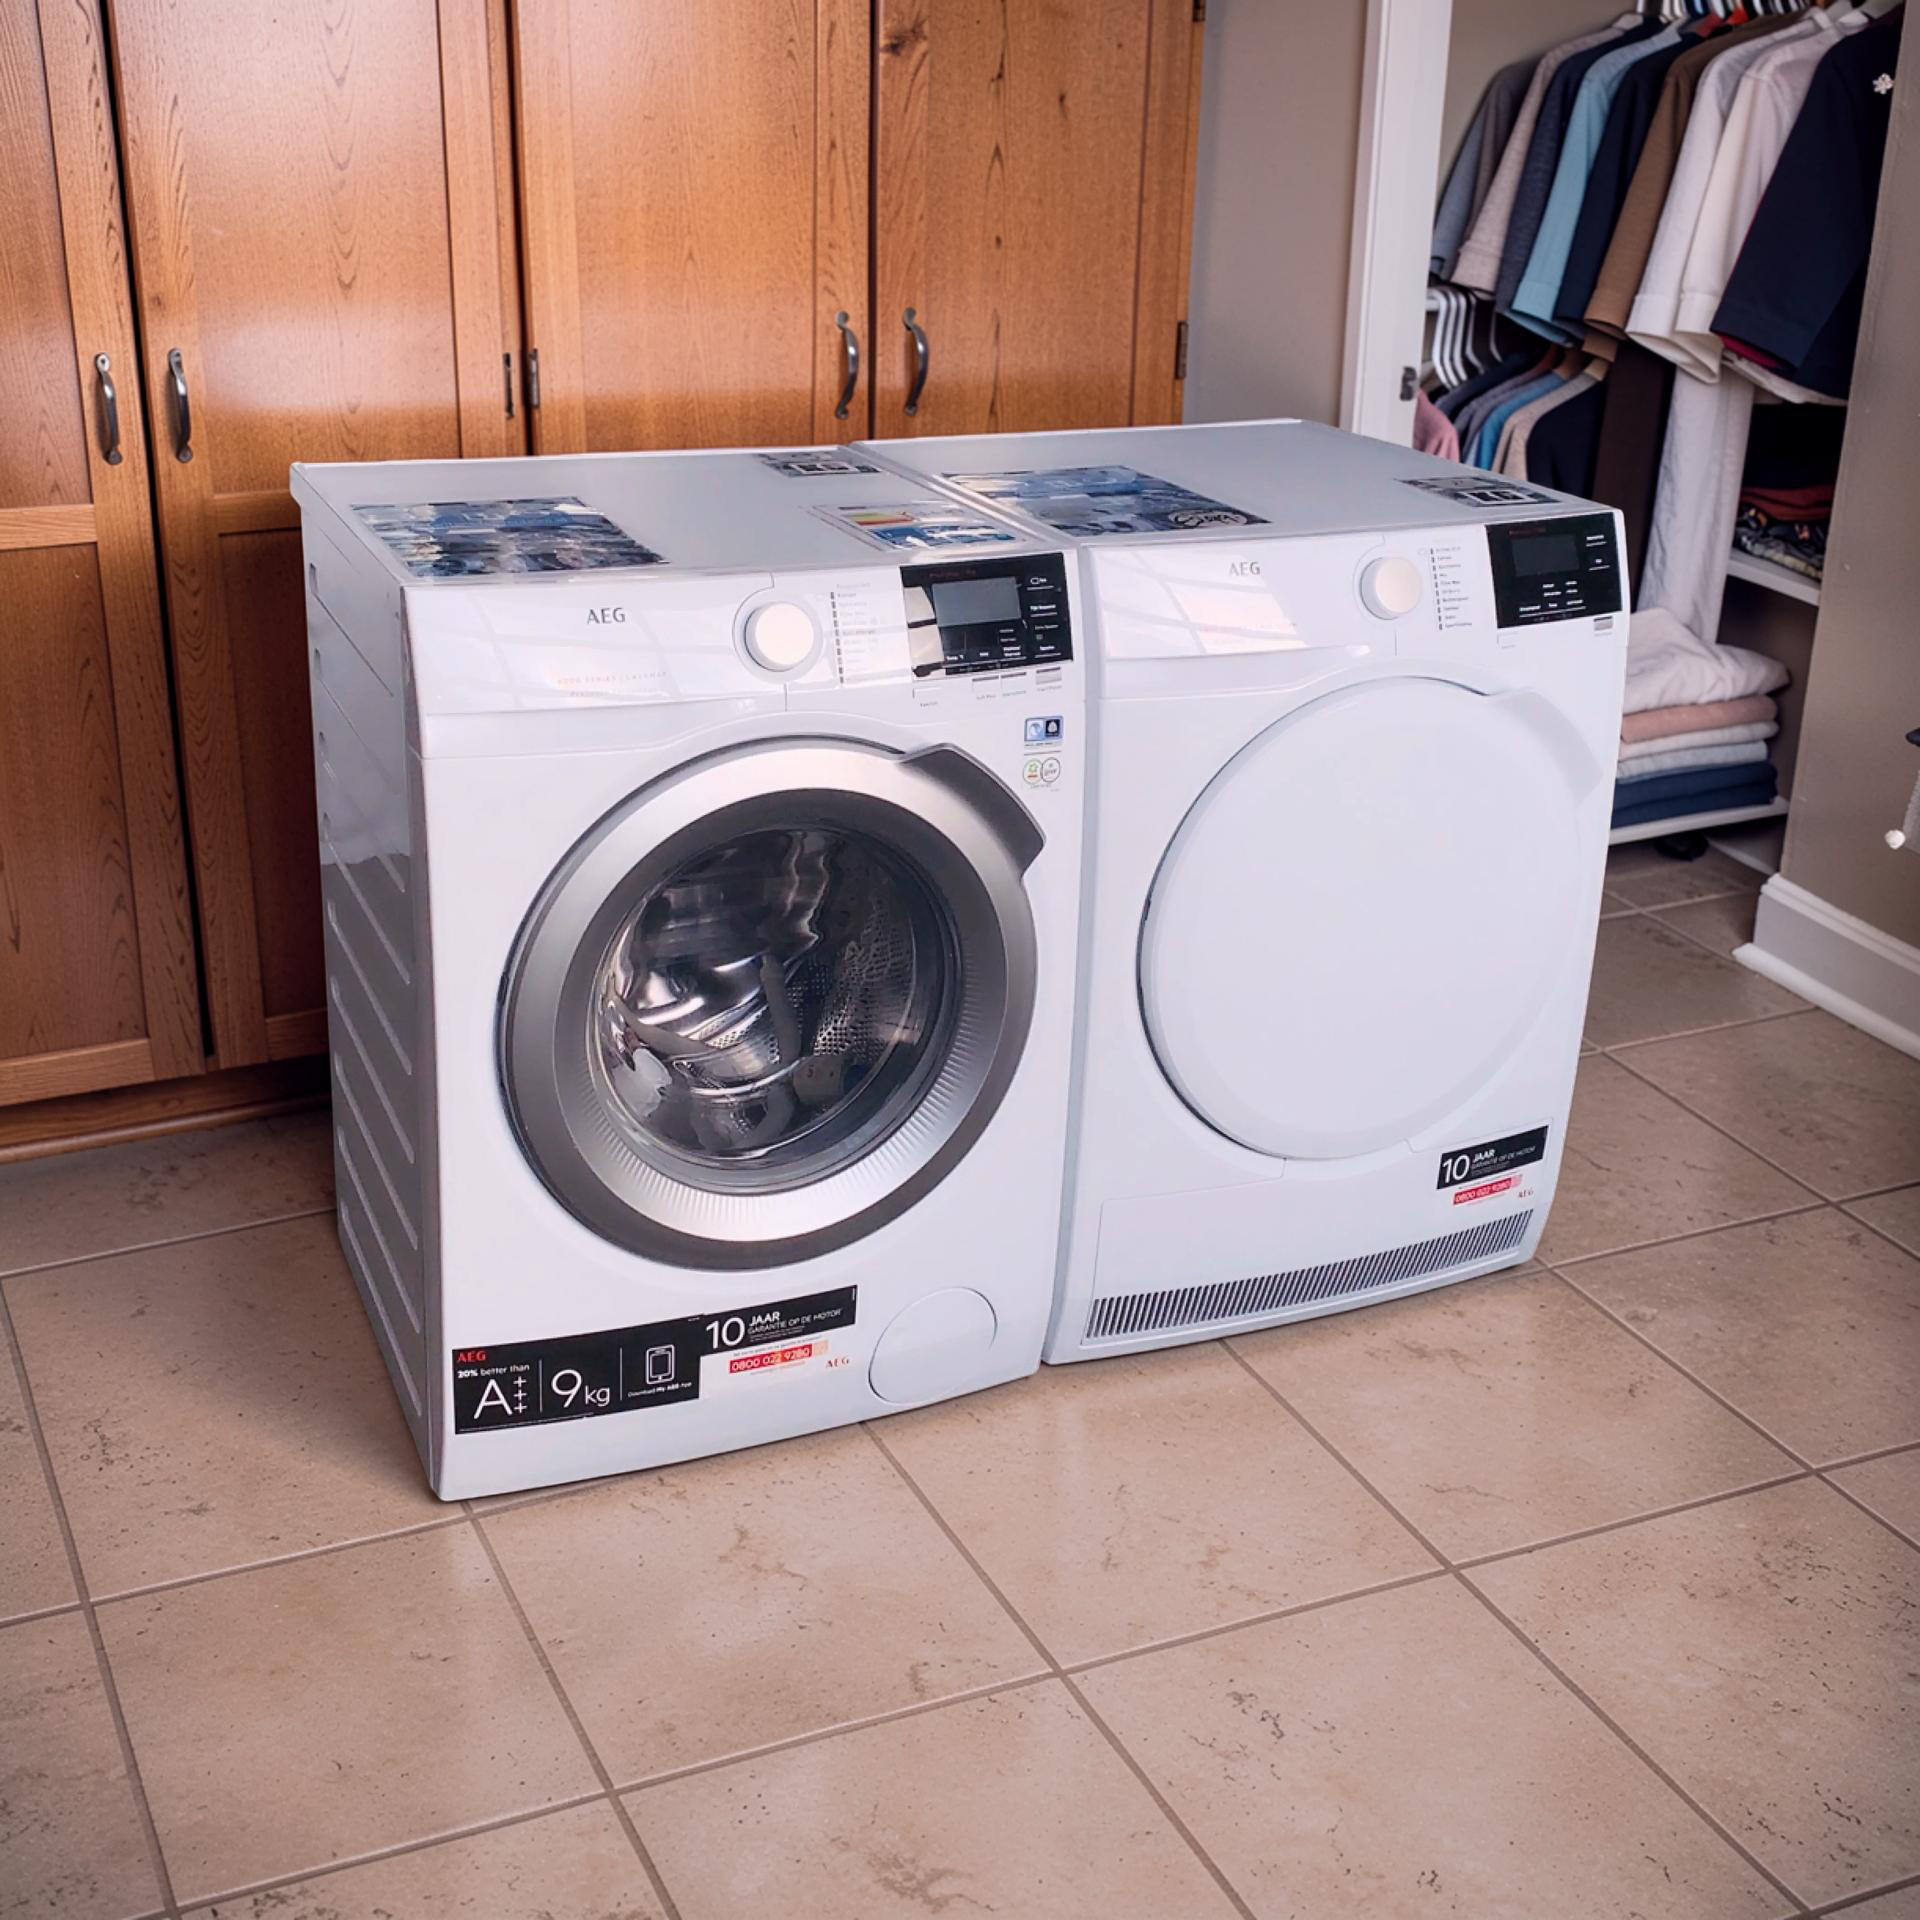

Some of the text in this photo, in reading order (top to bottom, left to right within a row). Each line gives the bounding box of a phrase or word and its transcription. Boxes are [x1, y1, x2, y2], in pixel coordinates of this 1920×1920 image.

[1229, 561, 1261, 577] AEG
[587, 606, 626, 625] AEG
[1443, 1154, 1470, 1183] 10
[1473, 1149, 1495, 1163] JAAR
[788, 1317, 800, 1327] OP
[801, 1314, 812, 1324] DE
[706, 1317, 745, 1349] 10
[749, 1311, 780, 1327] JAAR
[457, 1351, 486, 1363] AEG
[825, 1356, 849, 1369] AEG
[480, 1367, 507, 1377] better
[510, 1364, 530, 1373] than
[731, 1358, 760, 1371] 0800
